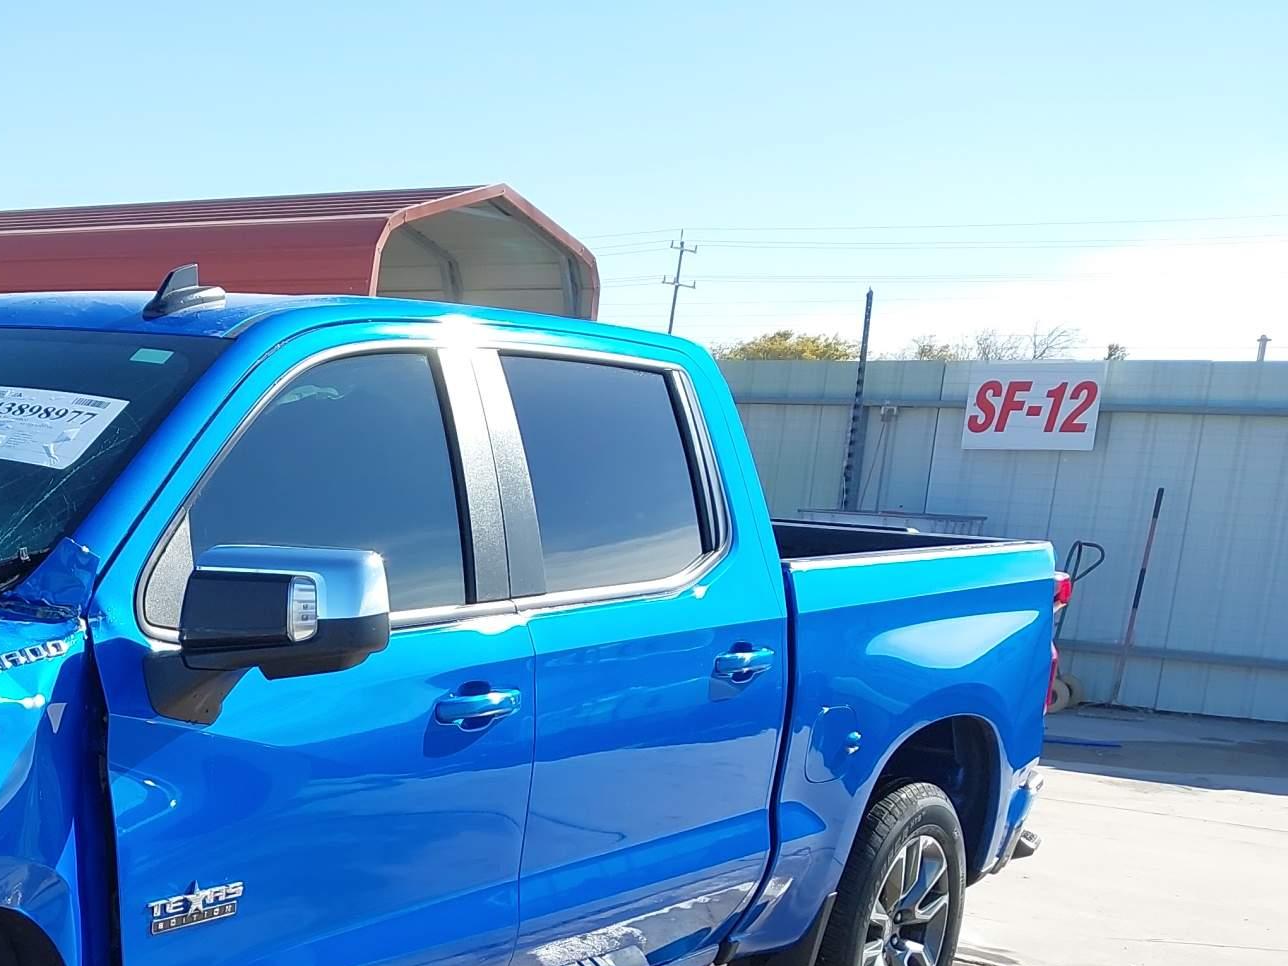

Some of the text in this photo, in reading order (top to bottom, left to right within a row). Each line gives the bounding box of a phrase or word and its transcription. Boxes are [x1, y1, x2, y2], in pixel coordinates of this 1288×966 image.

[967, 379, 1099, 433] SF-12
[147, 880, 245, 918] TEXAS
[157, 903, 233, 930] EDITION
